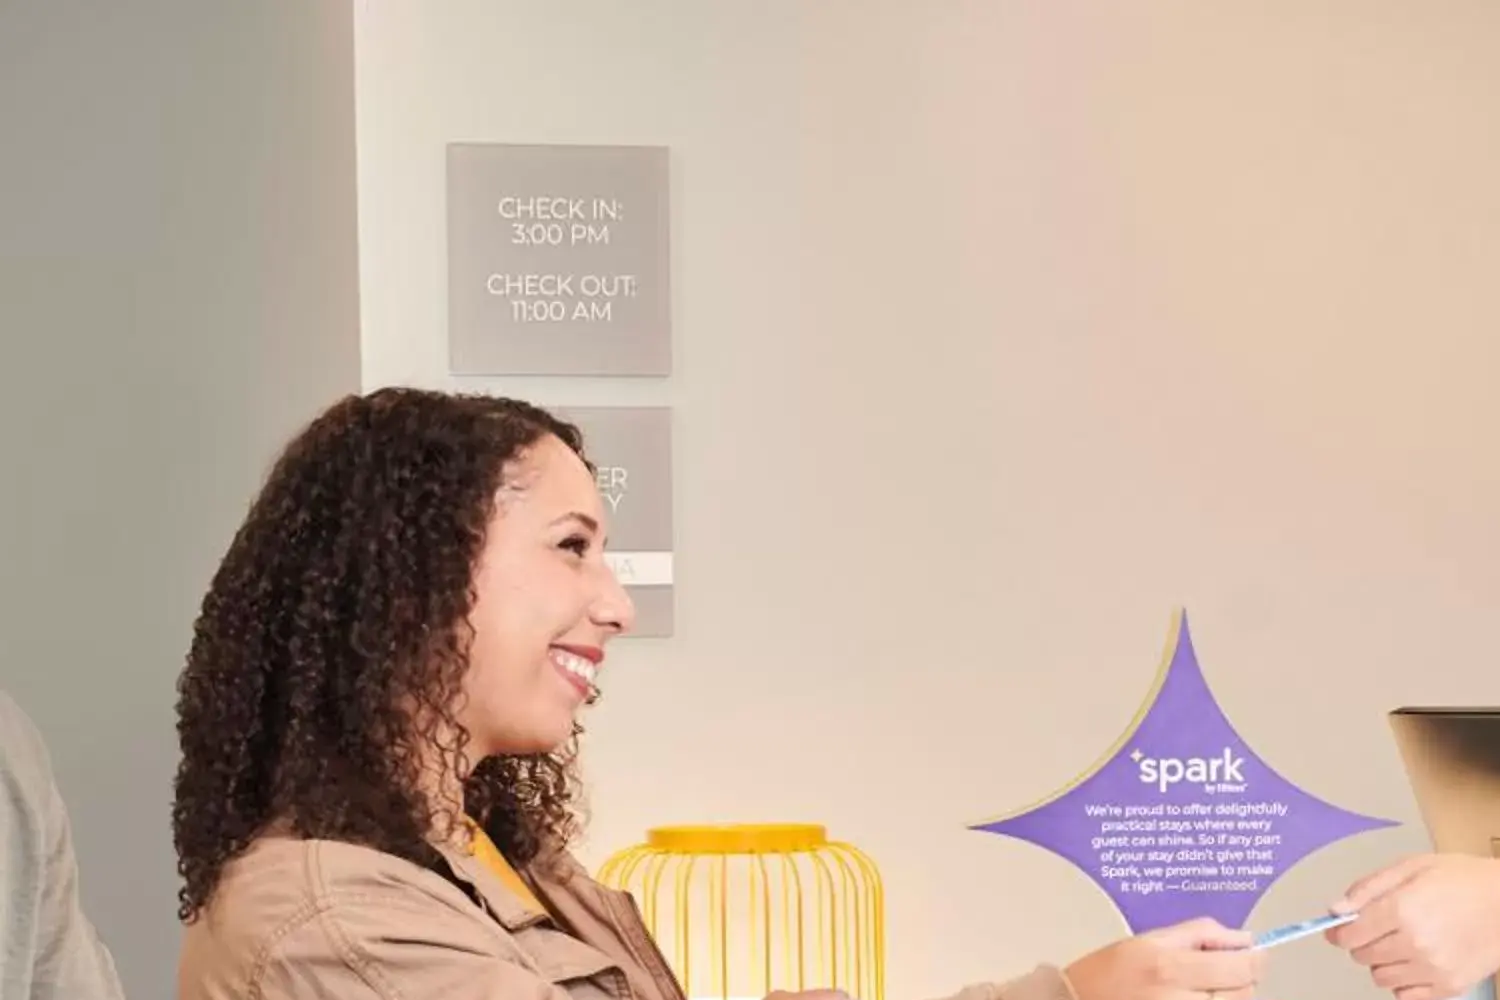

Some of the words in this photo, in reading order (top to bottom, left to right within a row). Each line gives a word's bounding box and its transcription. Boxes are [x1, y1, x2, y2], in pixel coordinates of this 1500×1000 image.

[498, 196, 585, 219] CHECK
[593, 198, 623, 220] IN:
[512, 223, 563, 245] 3:00
[571, 224, 609, 245] PM
[487, 273, 574, 296] CHECK
[580, 274, 636, 297] OUT:
[511, 300, 565, 322] 11:00
[571, 301, 612, 321] AM
[1138, 746, 1245, 793] spark
[1085, 804, 1122, 816] We're
[1125, 804, 1164, 819] proud
[1167, 804, 1180, 815] to
[1183, 803, 1212, 815] offer
[1215, 802, 1288, 817] delightfully
[1101, 819, 1157, 833] practical
[1159, 821, 1192, 834] stays
[1194, 819, 1234, 830] where
[1237, 821, 1272, 832] every
[1091, 835, 1129, 849] guest
[1131, 836, 1155, 845] can
[1198, 835, 1214, 845] So
[1217, 834, 1226, 845] if
[1229, 835, 1251, 848] any
[1254, 834, 1280, 848] part
[1101, 850, 1114, 861] of
[1115, 852, 1144, 864] your
[1148, 851, 1174, 863] stay
[1176, 849, 1213, 861] didn't
[1216, 849, 1243, 864] give
[1246, 848, 1273, 860] that
[1101, 865, 1140, 878] Spark,
[1143, 867, 1164, 876] we
[1165, 864, 1218, 878] promise
[1221, 865, 1234, 875] to
[1237, 863, 1273, 875] make
[1132, 880, 1164, 894] right
